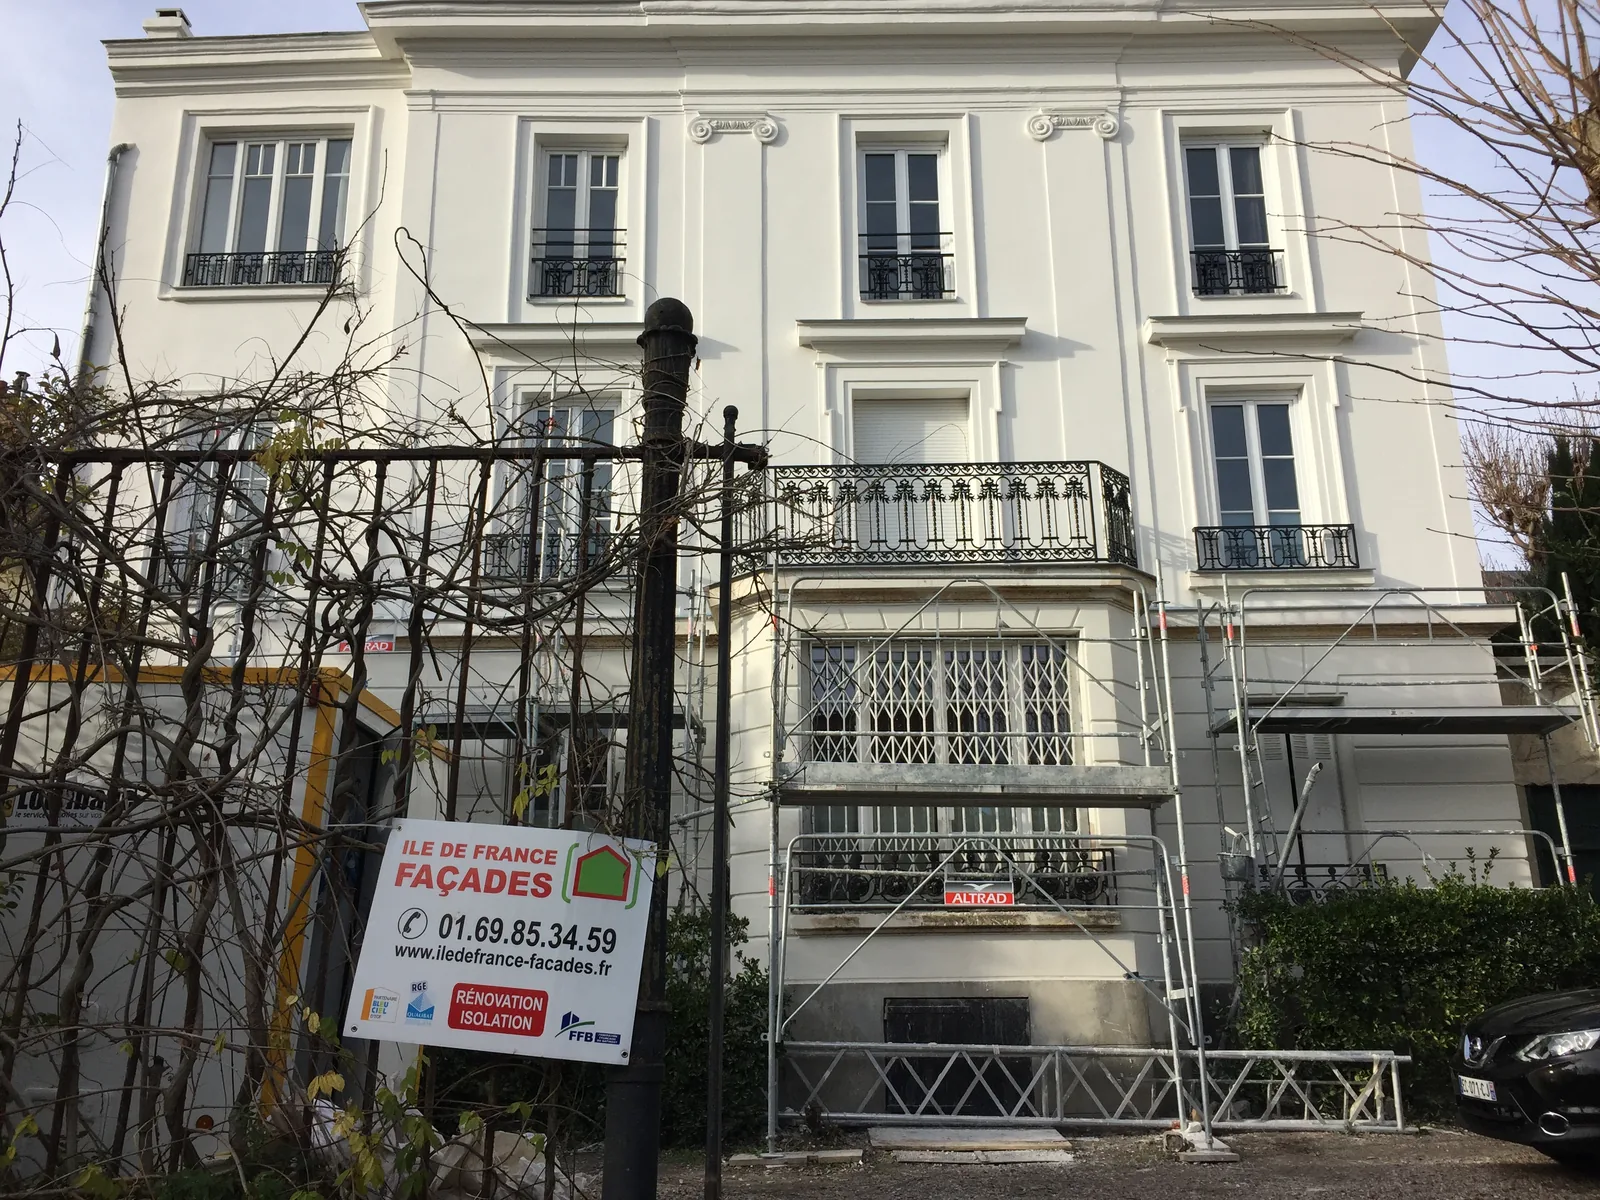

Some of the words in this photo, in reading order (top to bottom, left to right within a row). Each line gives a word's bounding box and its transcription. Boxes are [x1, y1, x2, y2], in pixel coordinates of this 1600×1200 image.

[342, 642, 388, 651] ARAD
[402, 840, 434, 856] ILE
[440, 842, 468, 859] DE
[473, 844, 558, 865] FRANCE
[394, 862, 553, 898] FAÇADES
[951, 893, 1007, 904] ALTRAD
[439, 913, 617, 954] 01.69.85.34.59
[395, 944, 612, 977] www.iledefrance-facades.fr
[411, 982, 427, 992] RGE
[456, 986, 543, 1011] RÉNOVATION
[460, 1009, 533, 1031] ISOLATION
[569, 1031, 593, 1043] FFB
